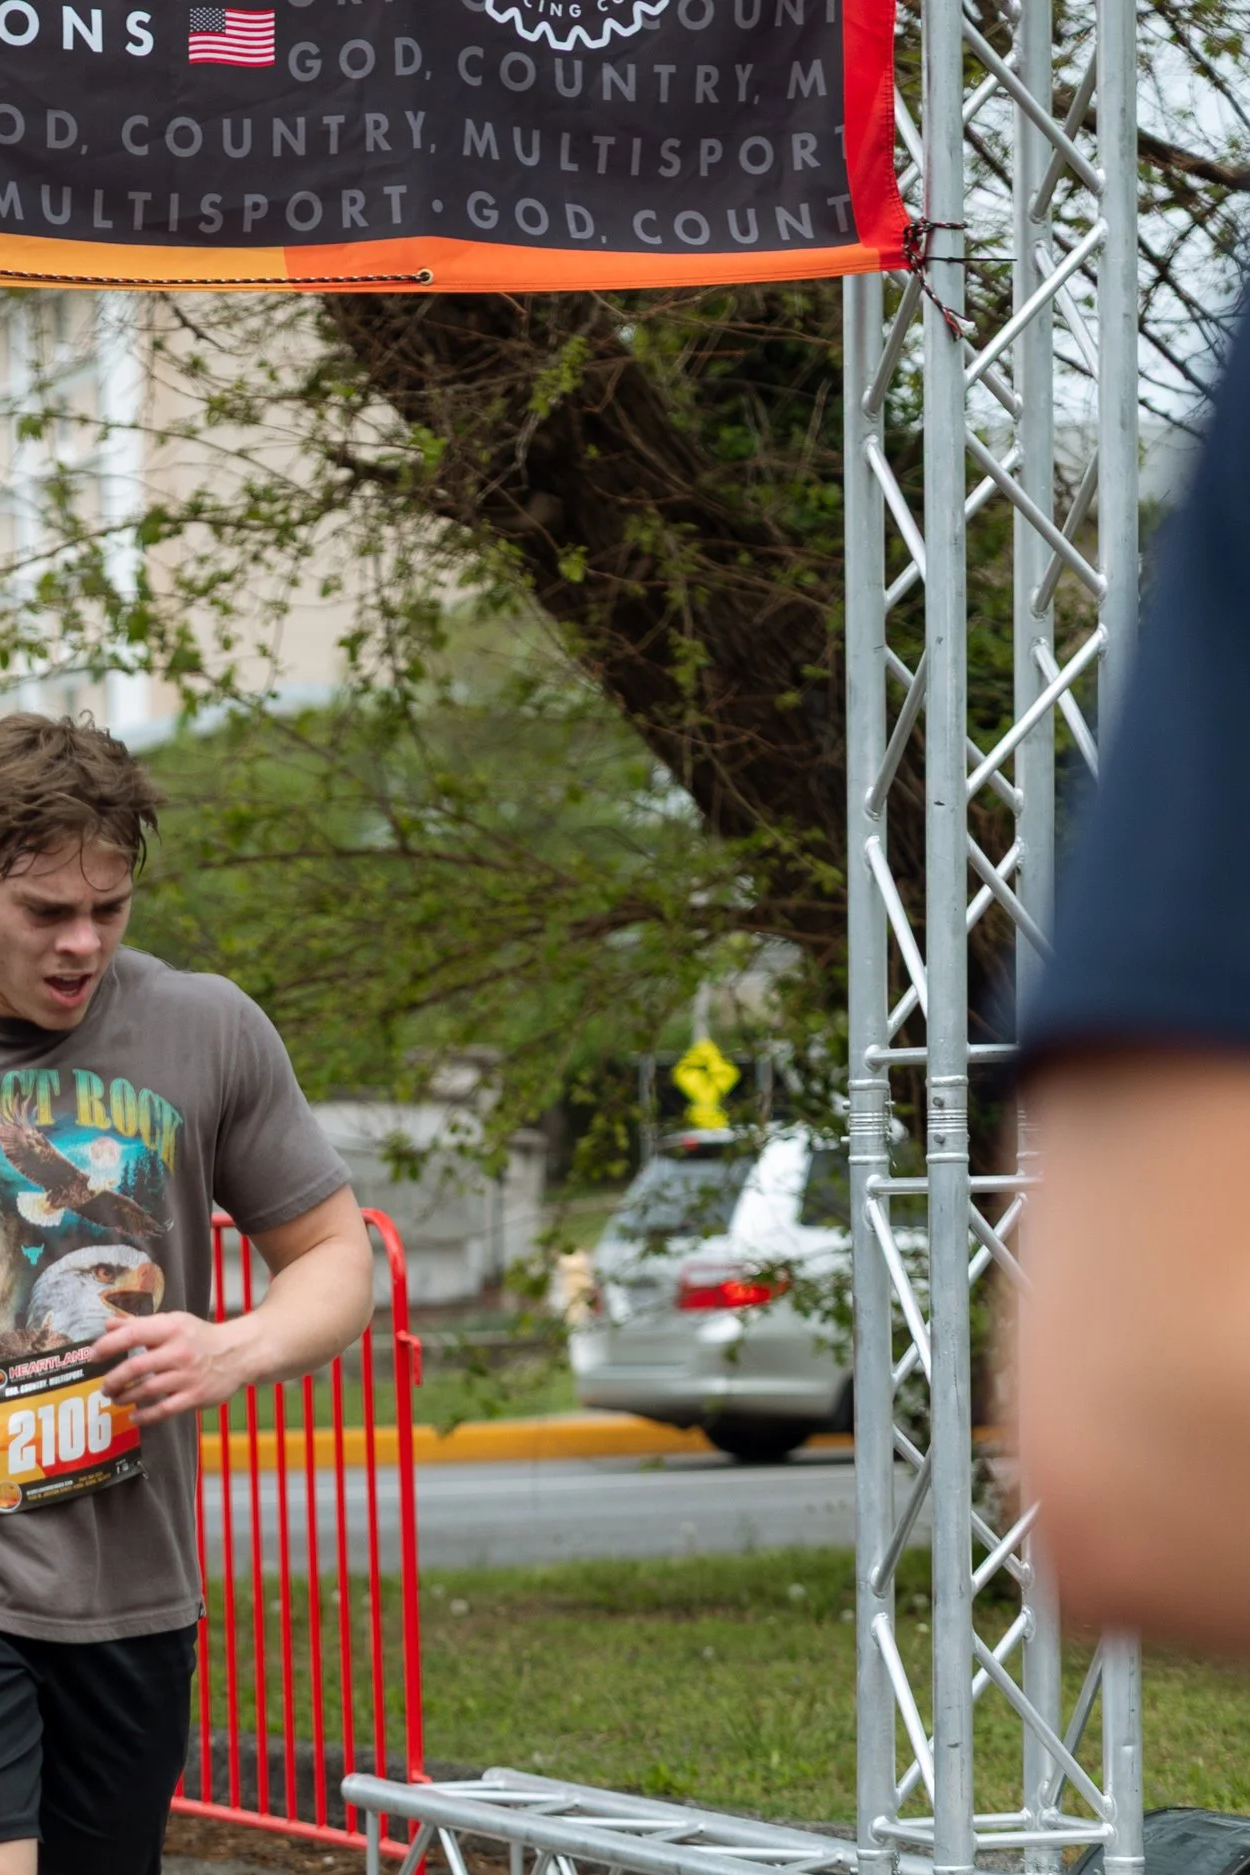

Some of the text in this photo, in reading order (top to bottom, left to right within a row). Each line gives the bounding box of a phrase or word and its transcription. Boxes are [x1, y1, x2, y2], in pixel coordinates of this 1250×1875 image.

[288, 36, 431, 82] GOD,
[457, 45, 759, 105] COUNTRY,
[121, 110, 436, 159] COUNTRY,
[466, 190, 607, 243] GOD,
[632, 194, 850, 245] COUNT
[72, 1068, 184, 1177] ROCK
[8, 1389, 112, 1475] 2106
